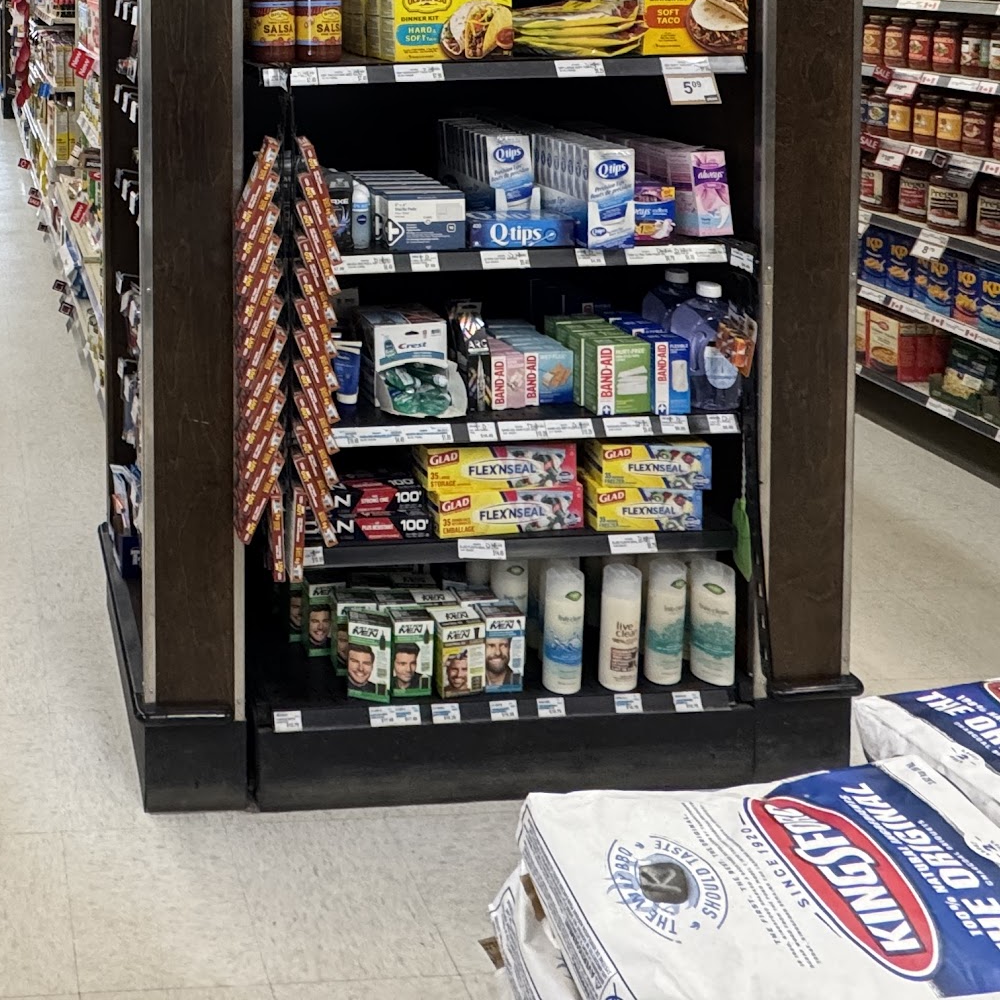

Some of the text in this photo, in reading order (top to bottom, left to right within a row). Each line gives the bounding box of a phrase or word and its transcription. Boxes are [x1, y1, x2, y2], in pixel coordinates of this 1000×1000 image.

[263, 24, 294, 34] SALSA
[316, 23, 341, 34] SALS
[405, 34, 426, 42] SOFT
[874, 66, 891, 78] SALE
[860, 136, 879, 149] SALE
[698, 170, 725, 181] always
[931, 189, 958, 199] Prego
[73, 206, 83, 220] New
[490, 223, 543, 246] Q-tips
[398, 341, 427, 350] Crest
[658, 344, 668, 382] BAND-AID
[527, 354, 537, 399] BAND-AID
[601, 348, 613, 398] BAND-AID
[494, 361, 506, 405] BAND-AID
[429, 451, 458, 465] GLAD
[605, 448, 632, 459] GLAD
[431, 472, 439, 480] 35
[430, 480, 456, 488] STORAGE
[395, 491, 422, 503] 100'
[599, 491, 625, 503] GLAD
[441, 498, 470, 512] GLAD
[401, 519, 429, 531] 100'
[443, 518, 451, 526] 35
[490, 622, 514, 630] MEN
[617, 622, 634, 631] live
[352, 628, 378, 638] MEN
[446, 632, 470, 640] MEN
[916, 691, 977, 717] THE
[953, 721, 992, 750] CHARCOAL
[840, 782, 980, 890] ORIGINAL
[741, 827, 810, 909] SINCE 1920
[898, 846, 949, 894] NATURAL
[764, 804, 923, 952] KINGSFORD
[615, 840, 722, 935] THE WAY BBQ SHOULD TASTE
[945, 896, 984, 937] 100%
